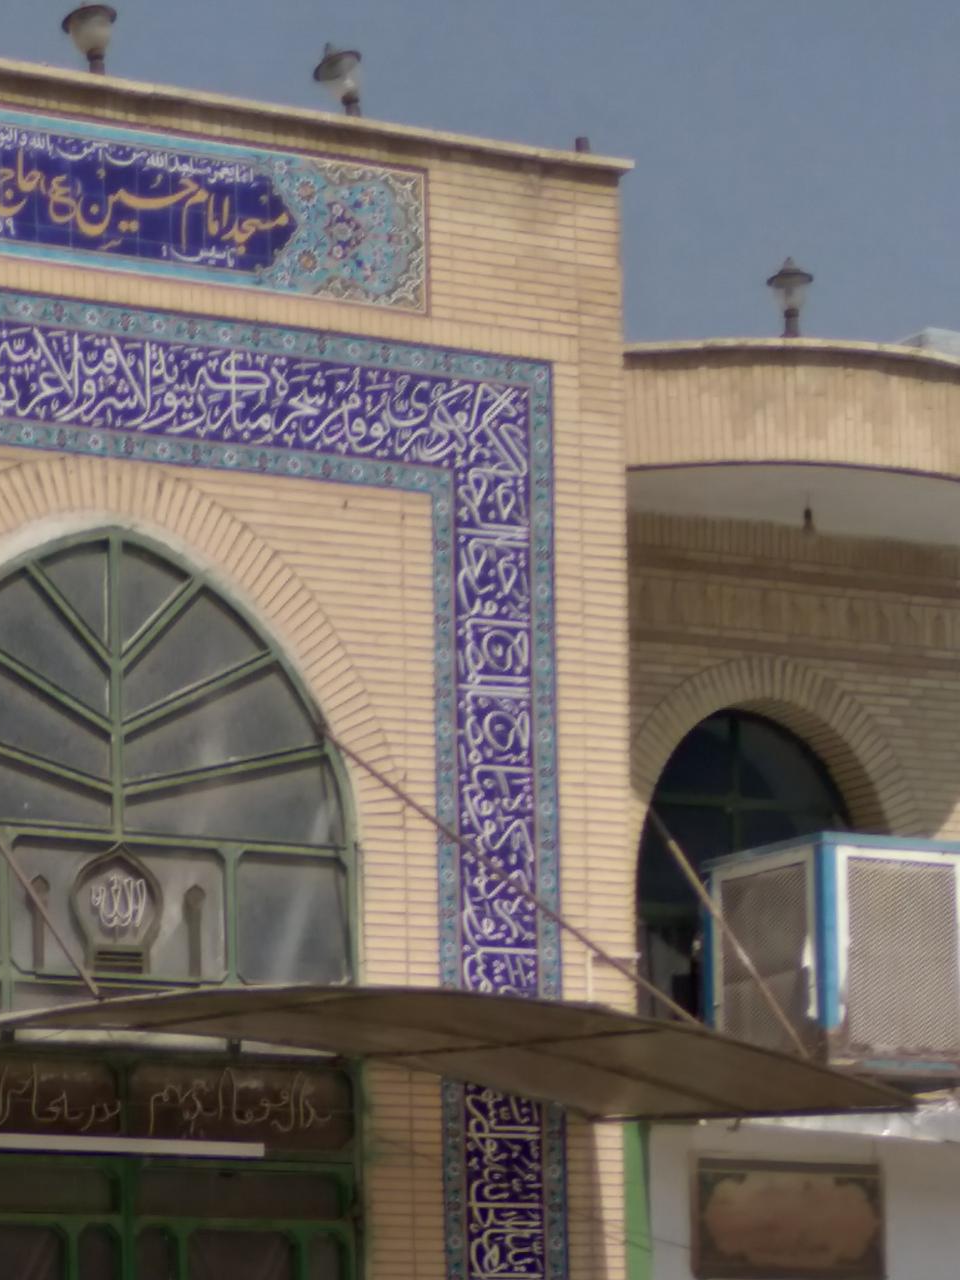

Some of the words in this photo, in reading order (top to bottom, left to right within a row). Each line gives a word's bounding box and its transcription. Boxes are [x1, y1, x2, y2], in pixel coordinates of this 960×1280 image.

[180, 186, 230, 253] امام
[221, 211, 289, 254] مسجد
[90, 872, 146, 927] الله
